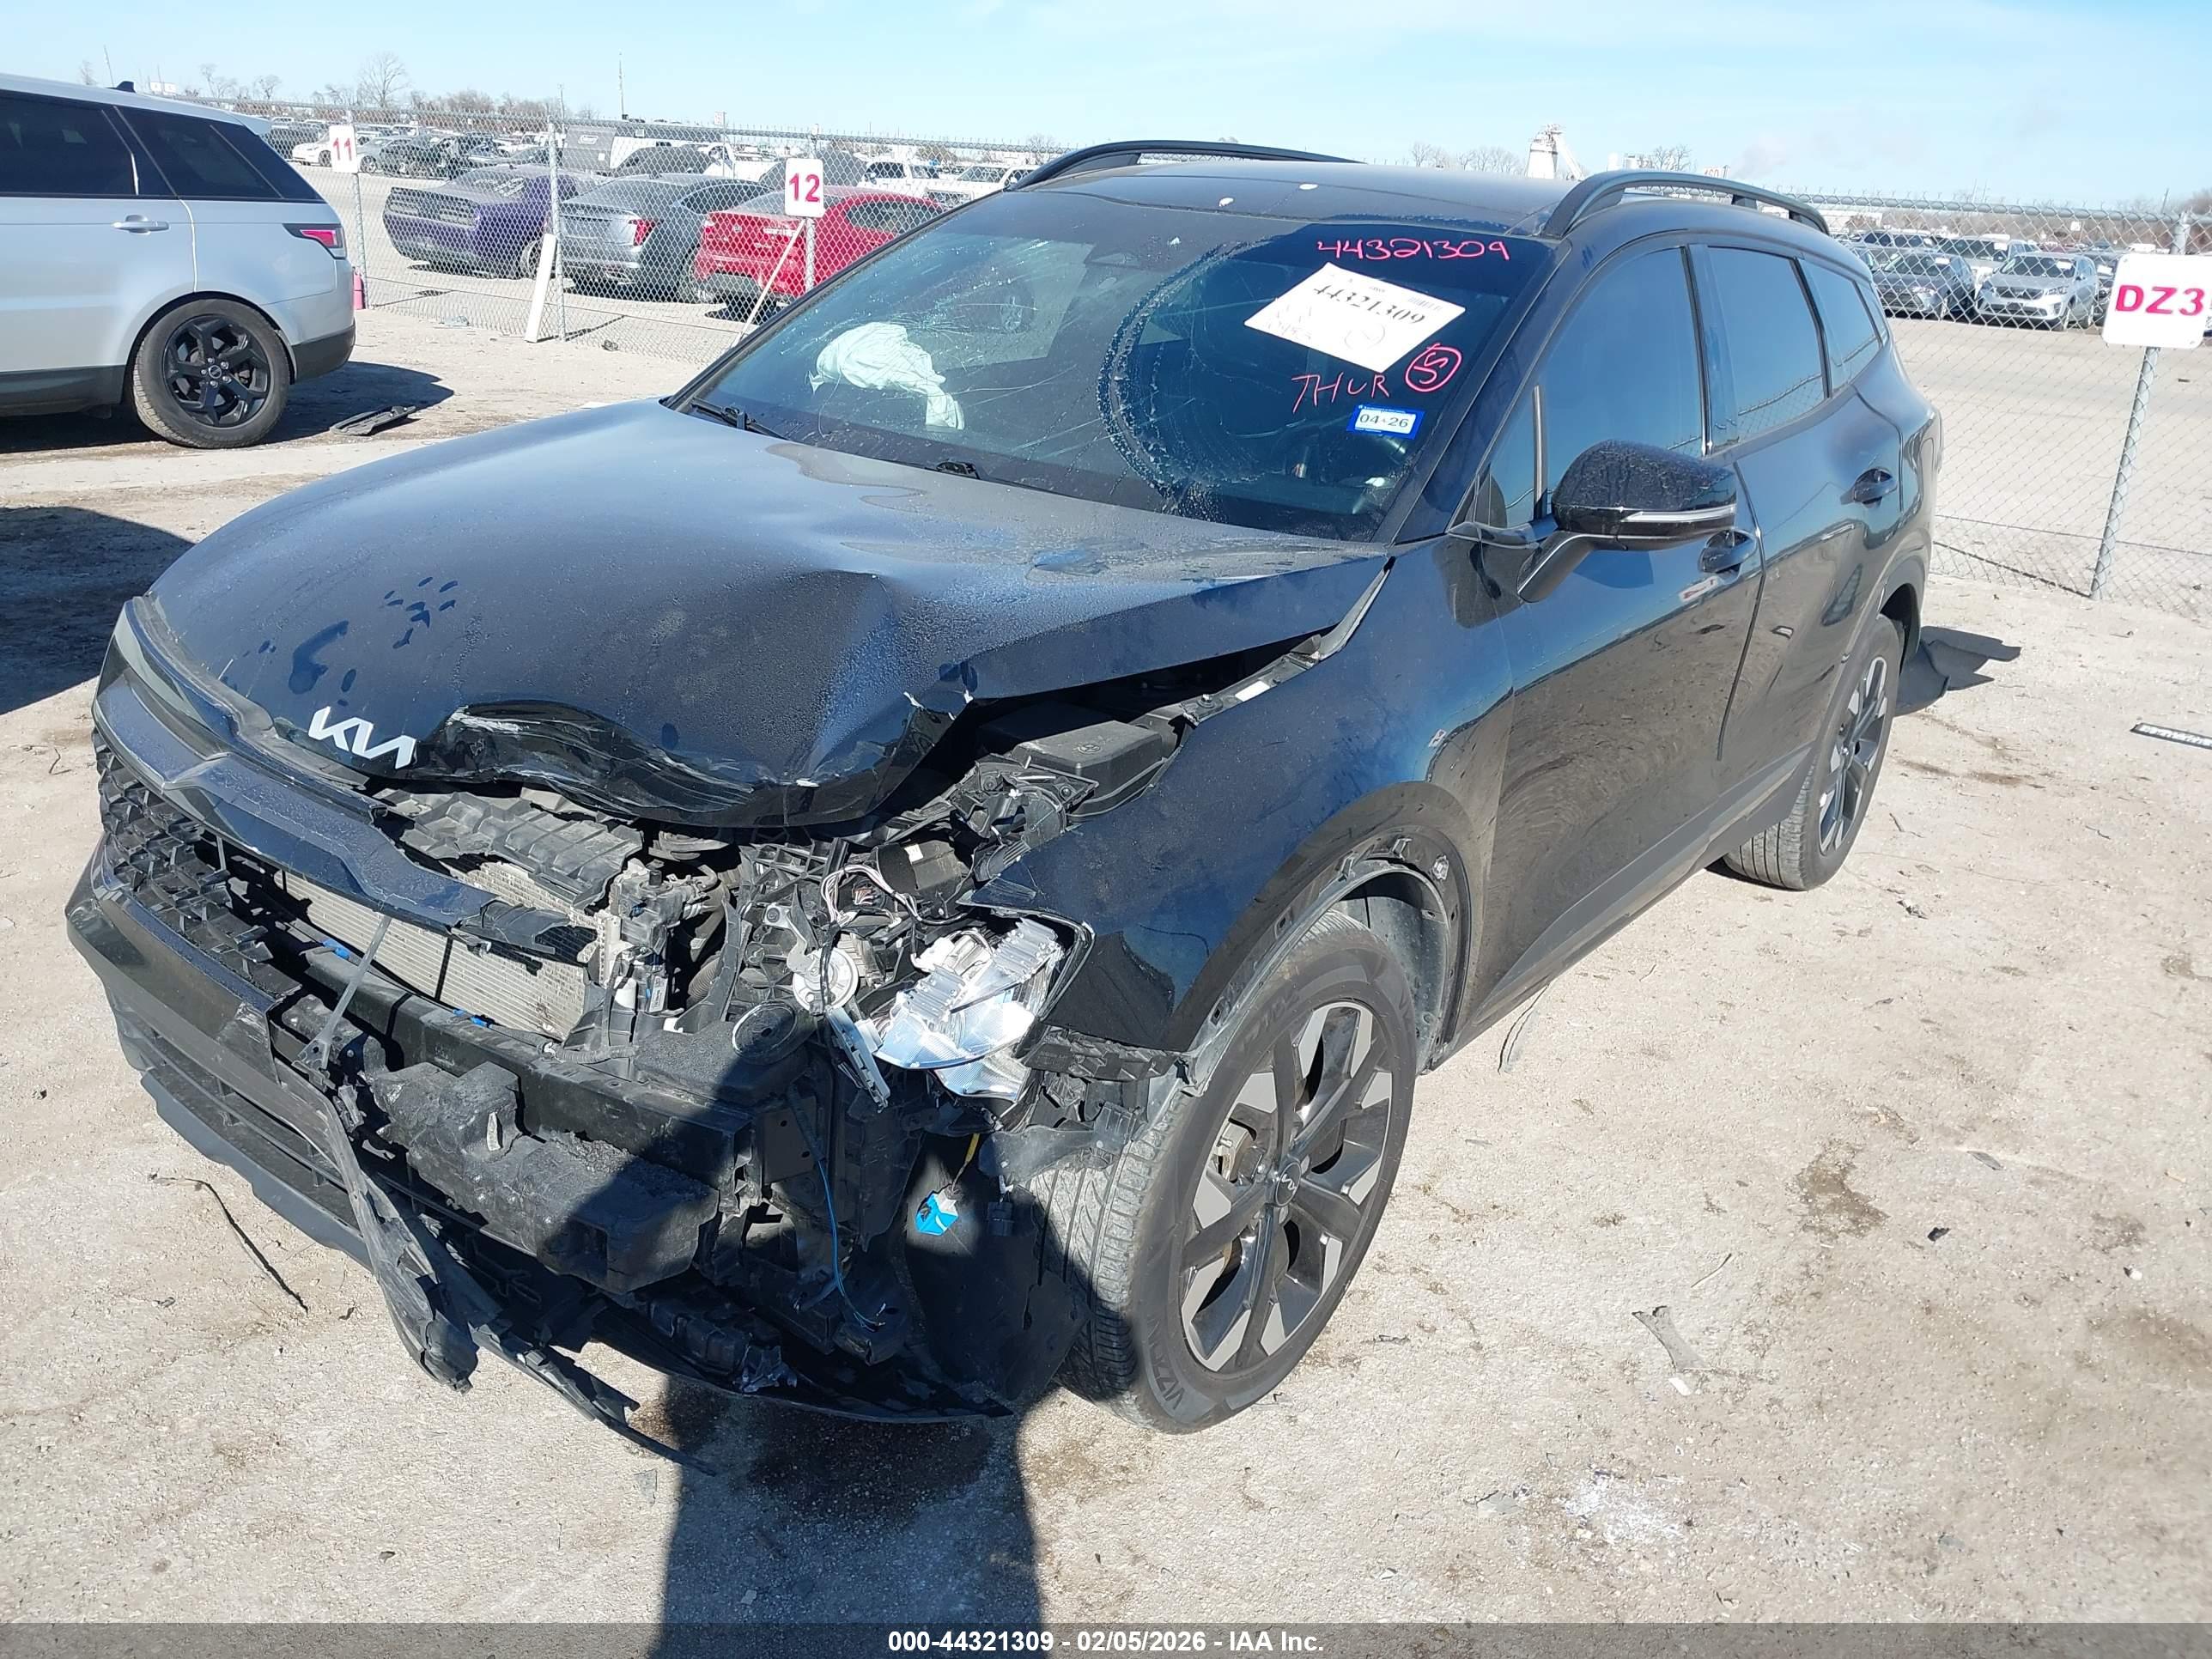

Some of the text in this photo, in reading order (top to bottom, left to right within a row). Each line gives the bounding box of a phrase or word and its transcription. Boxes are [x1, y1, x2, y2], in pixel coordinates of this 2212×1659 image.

[332, 137, 352, 161] 11
[789, 173, 820, 202] 12
[1317, 238, 1510, 260] 44321309
[1313, 284, 1426, 325] 44321309
[2115, 284, 2205, 316] DZ3
[1291, 371, 1389, 413] THUR
[308, 706, 416, 770] KIA
